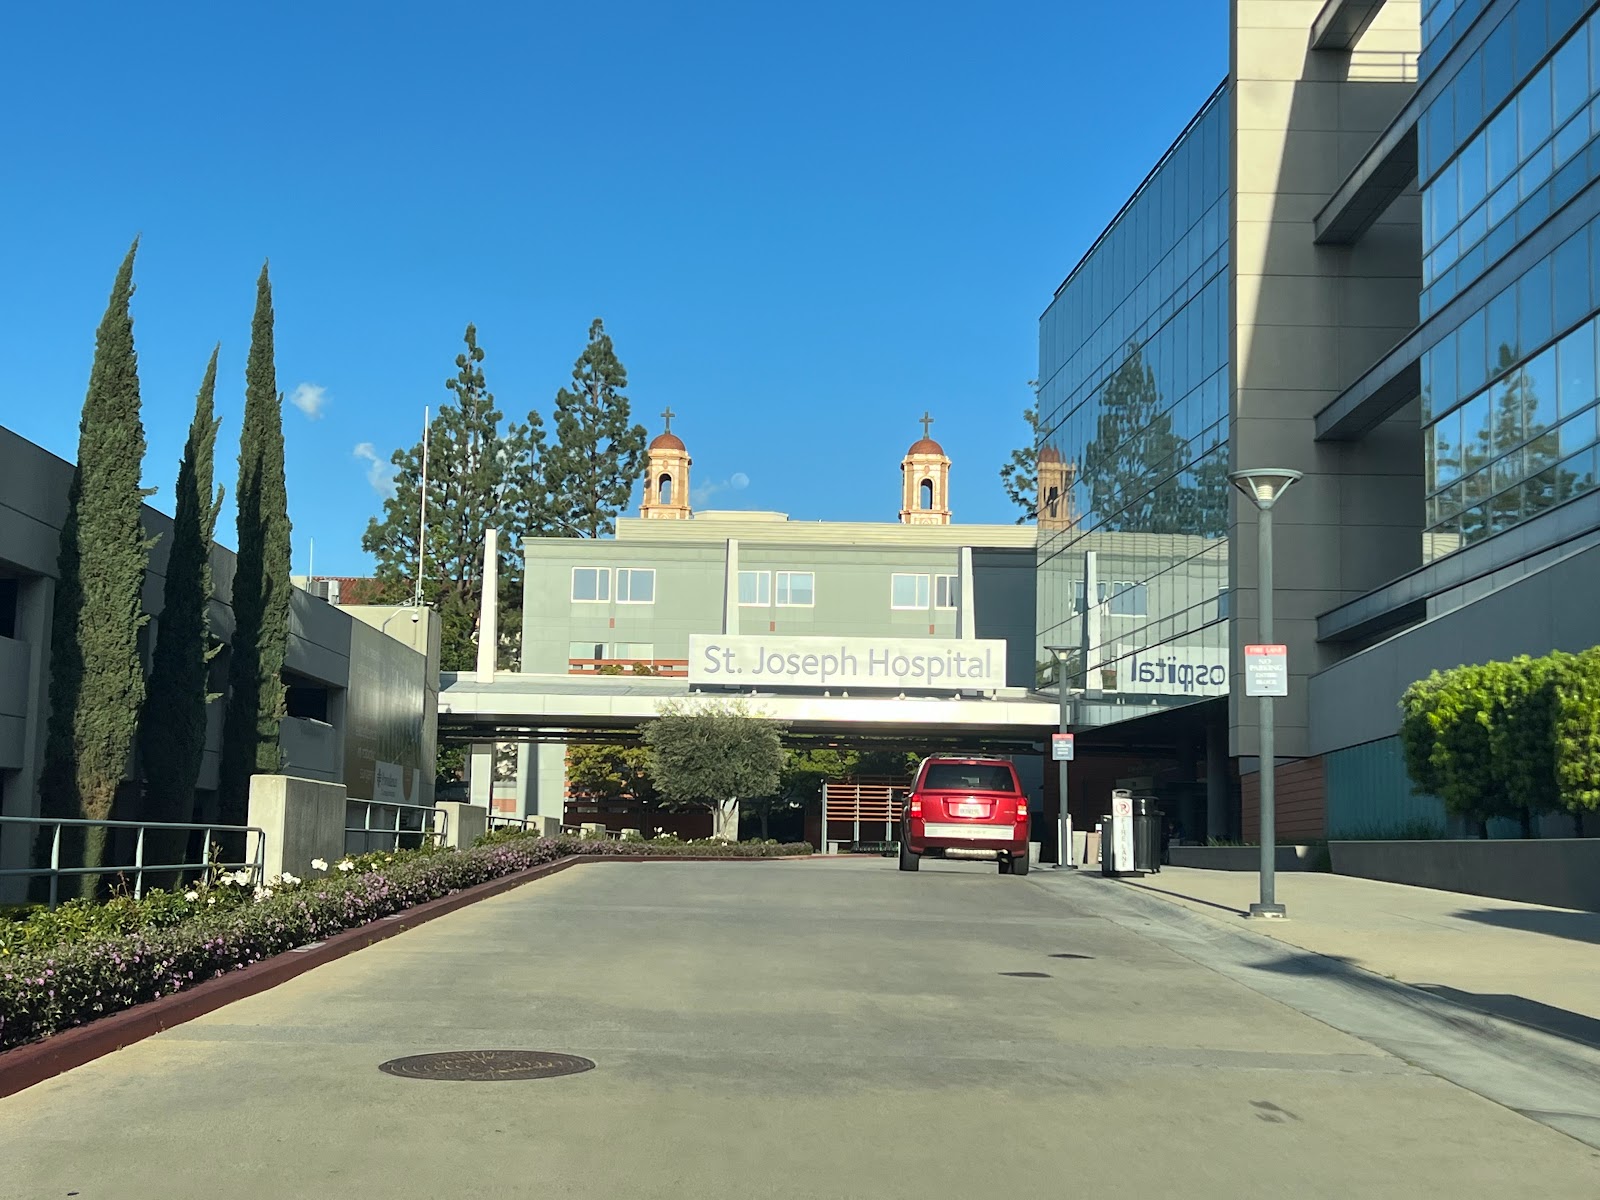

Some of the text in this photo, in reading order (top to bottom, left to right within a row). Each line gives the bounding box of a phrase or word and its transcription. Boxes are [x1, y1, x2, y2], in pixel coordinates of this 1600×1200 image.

[703, 645, 991, 685] St. Joseph Hospital
